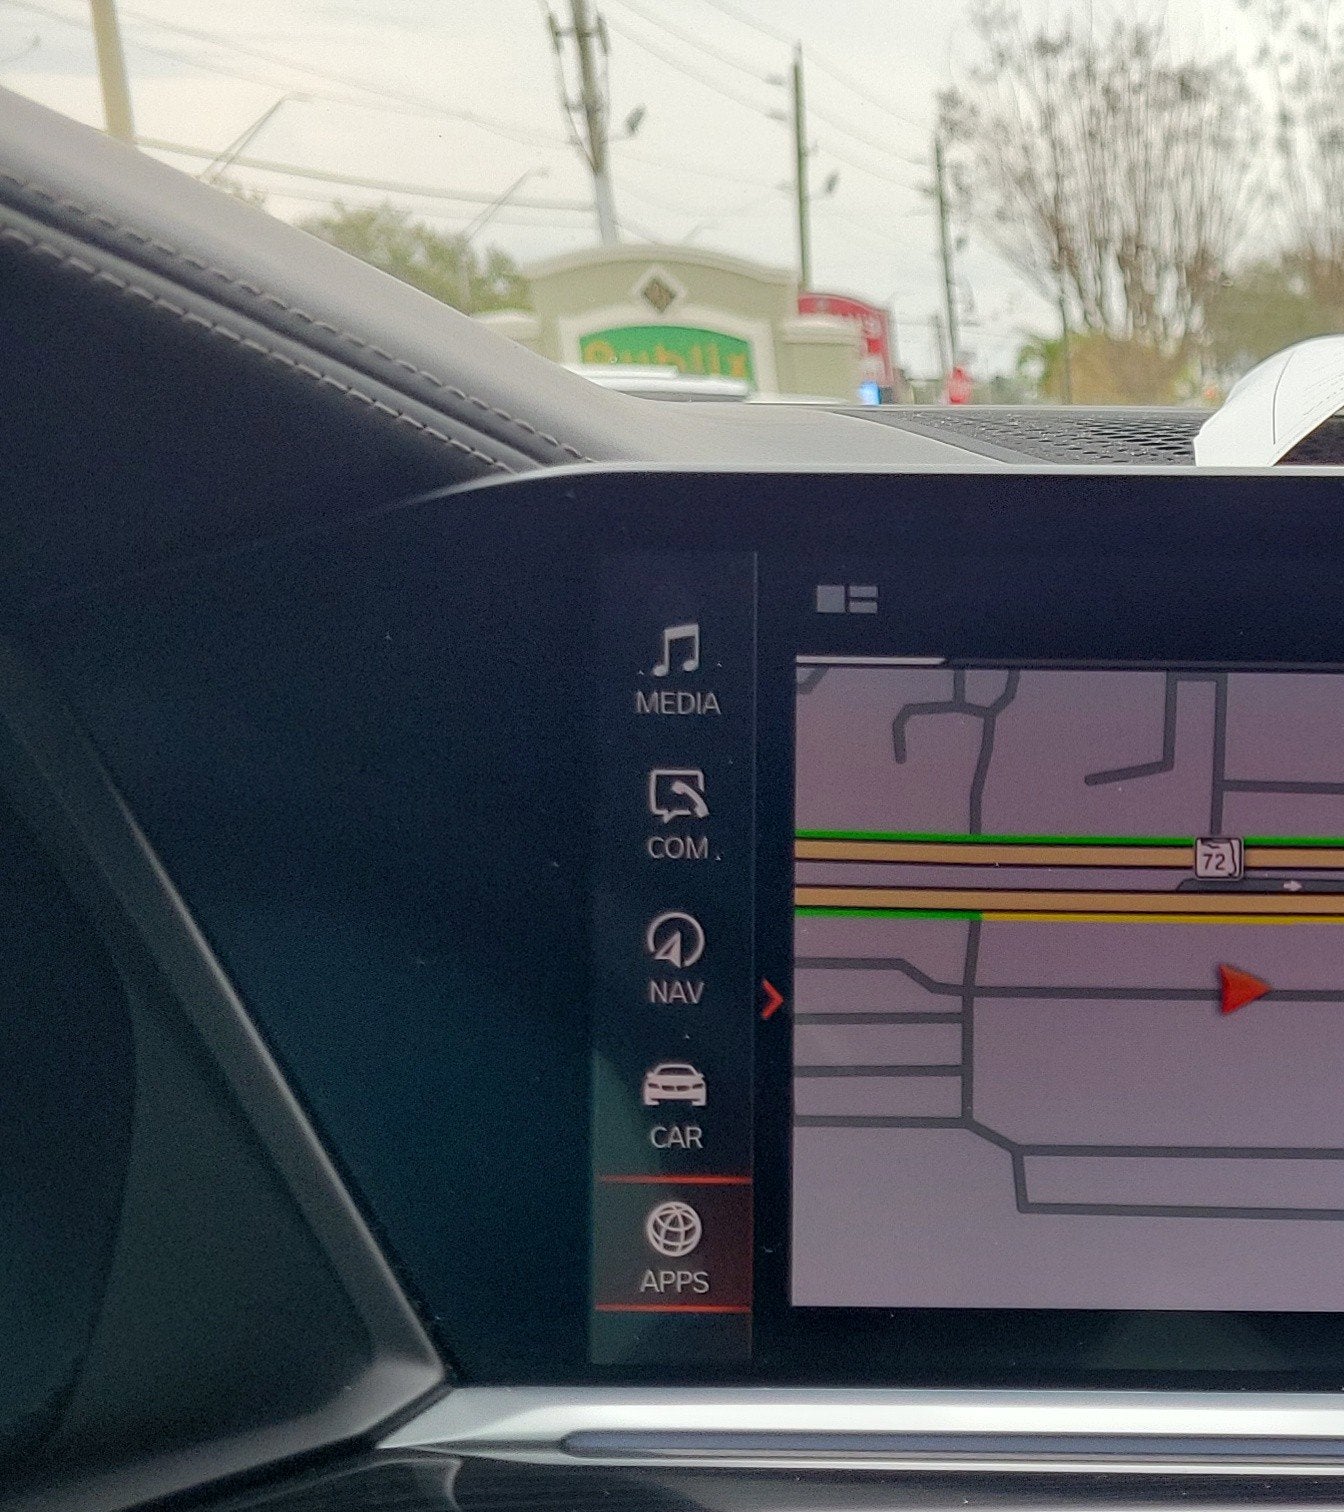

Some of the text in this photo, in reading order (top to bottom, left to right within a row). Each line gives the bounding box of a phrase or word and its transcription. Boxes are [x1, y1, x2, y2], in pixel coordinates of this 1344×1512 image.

[636, 691, 720, 714] MEDIA
[647, 836, 708, 859] COM
[1202, 851, 1227, 872] 72
[650, 980, 704, 1003] NAV
[648, 1125, 702, 1148] CAR
[640, 1269, 708, 1293] APPS
